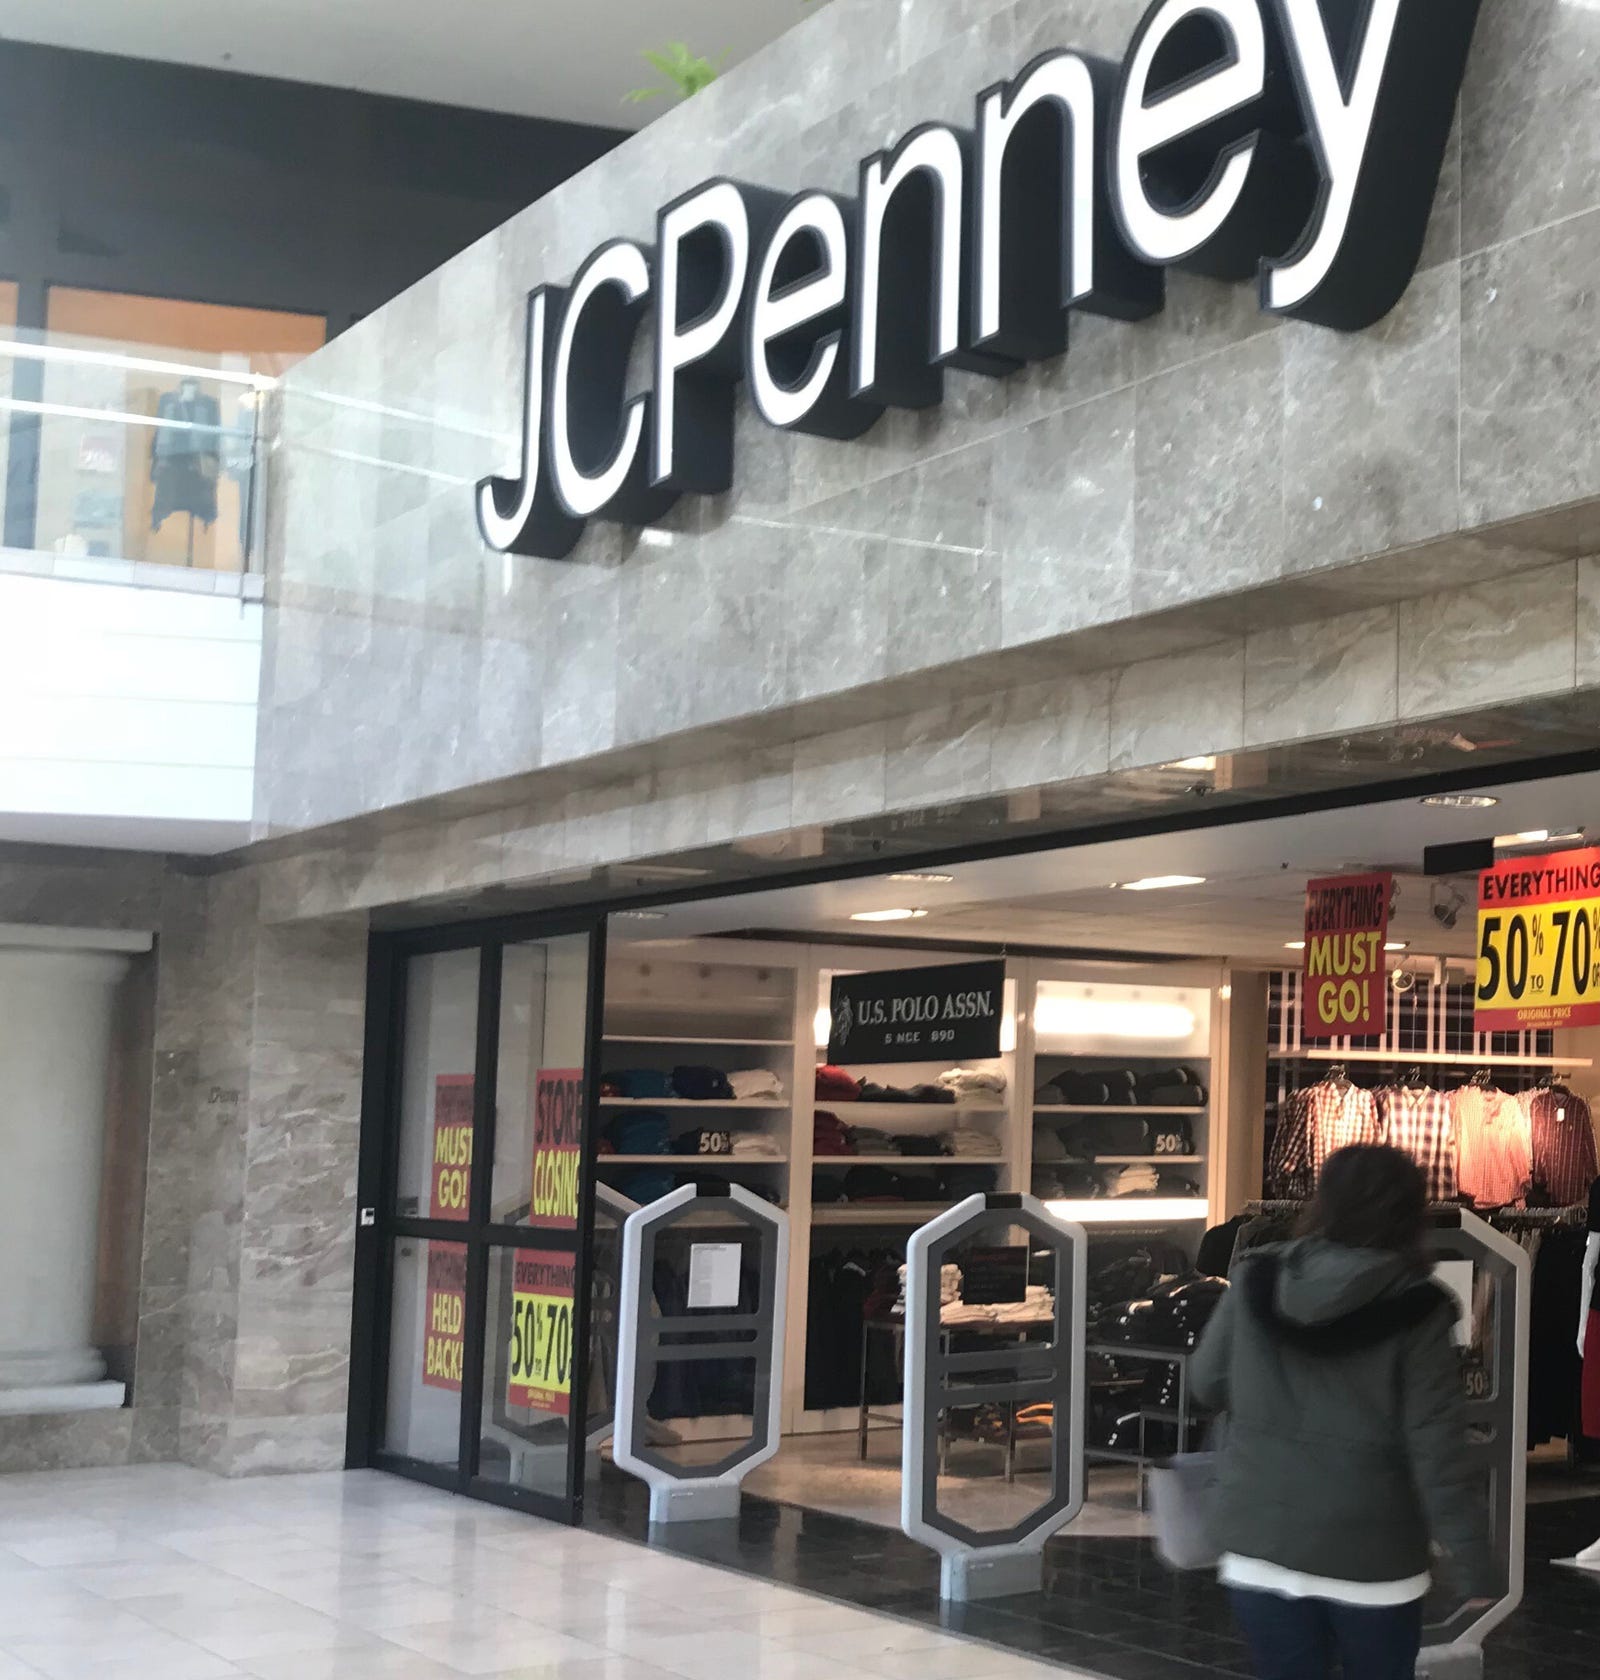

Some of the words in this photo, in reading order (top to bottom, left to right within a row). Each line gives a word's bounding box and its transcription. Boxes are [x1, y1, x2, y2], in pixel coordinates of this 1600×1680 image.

[475, 0, 1412, 556] JCPenney
[1308, 883, 1384, 931] EVERYTHING
[1308, 931, 1382, 977] MUST
[858, 999, 888, 1025] U.S.
[891, 994, 939, 1023] POLO
[942, 990, 995, 1019] ASSN.
[1318, 979, 1370, 1024] GO!
[1517, 1007, 1551, 1021] ORIGINAL
[1553, 1006, 1571, 1017] PRICE
[884, 1032, 921, 1045] SNCE
[929, 1030, 955, 1042] 890
[537, 1078, 583, 1146] STORE
[434, 1126, 473, 1165] MUST
[438, 1168, 467, 1208] GO!
[432, 1292, 462, 1335] HELD
